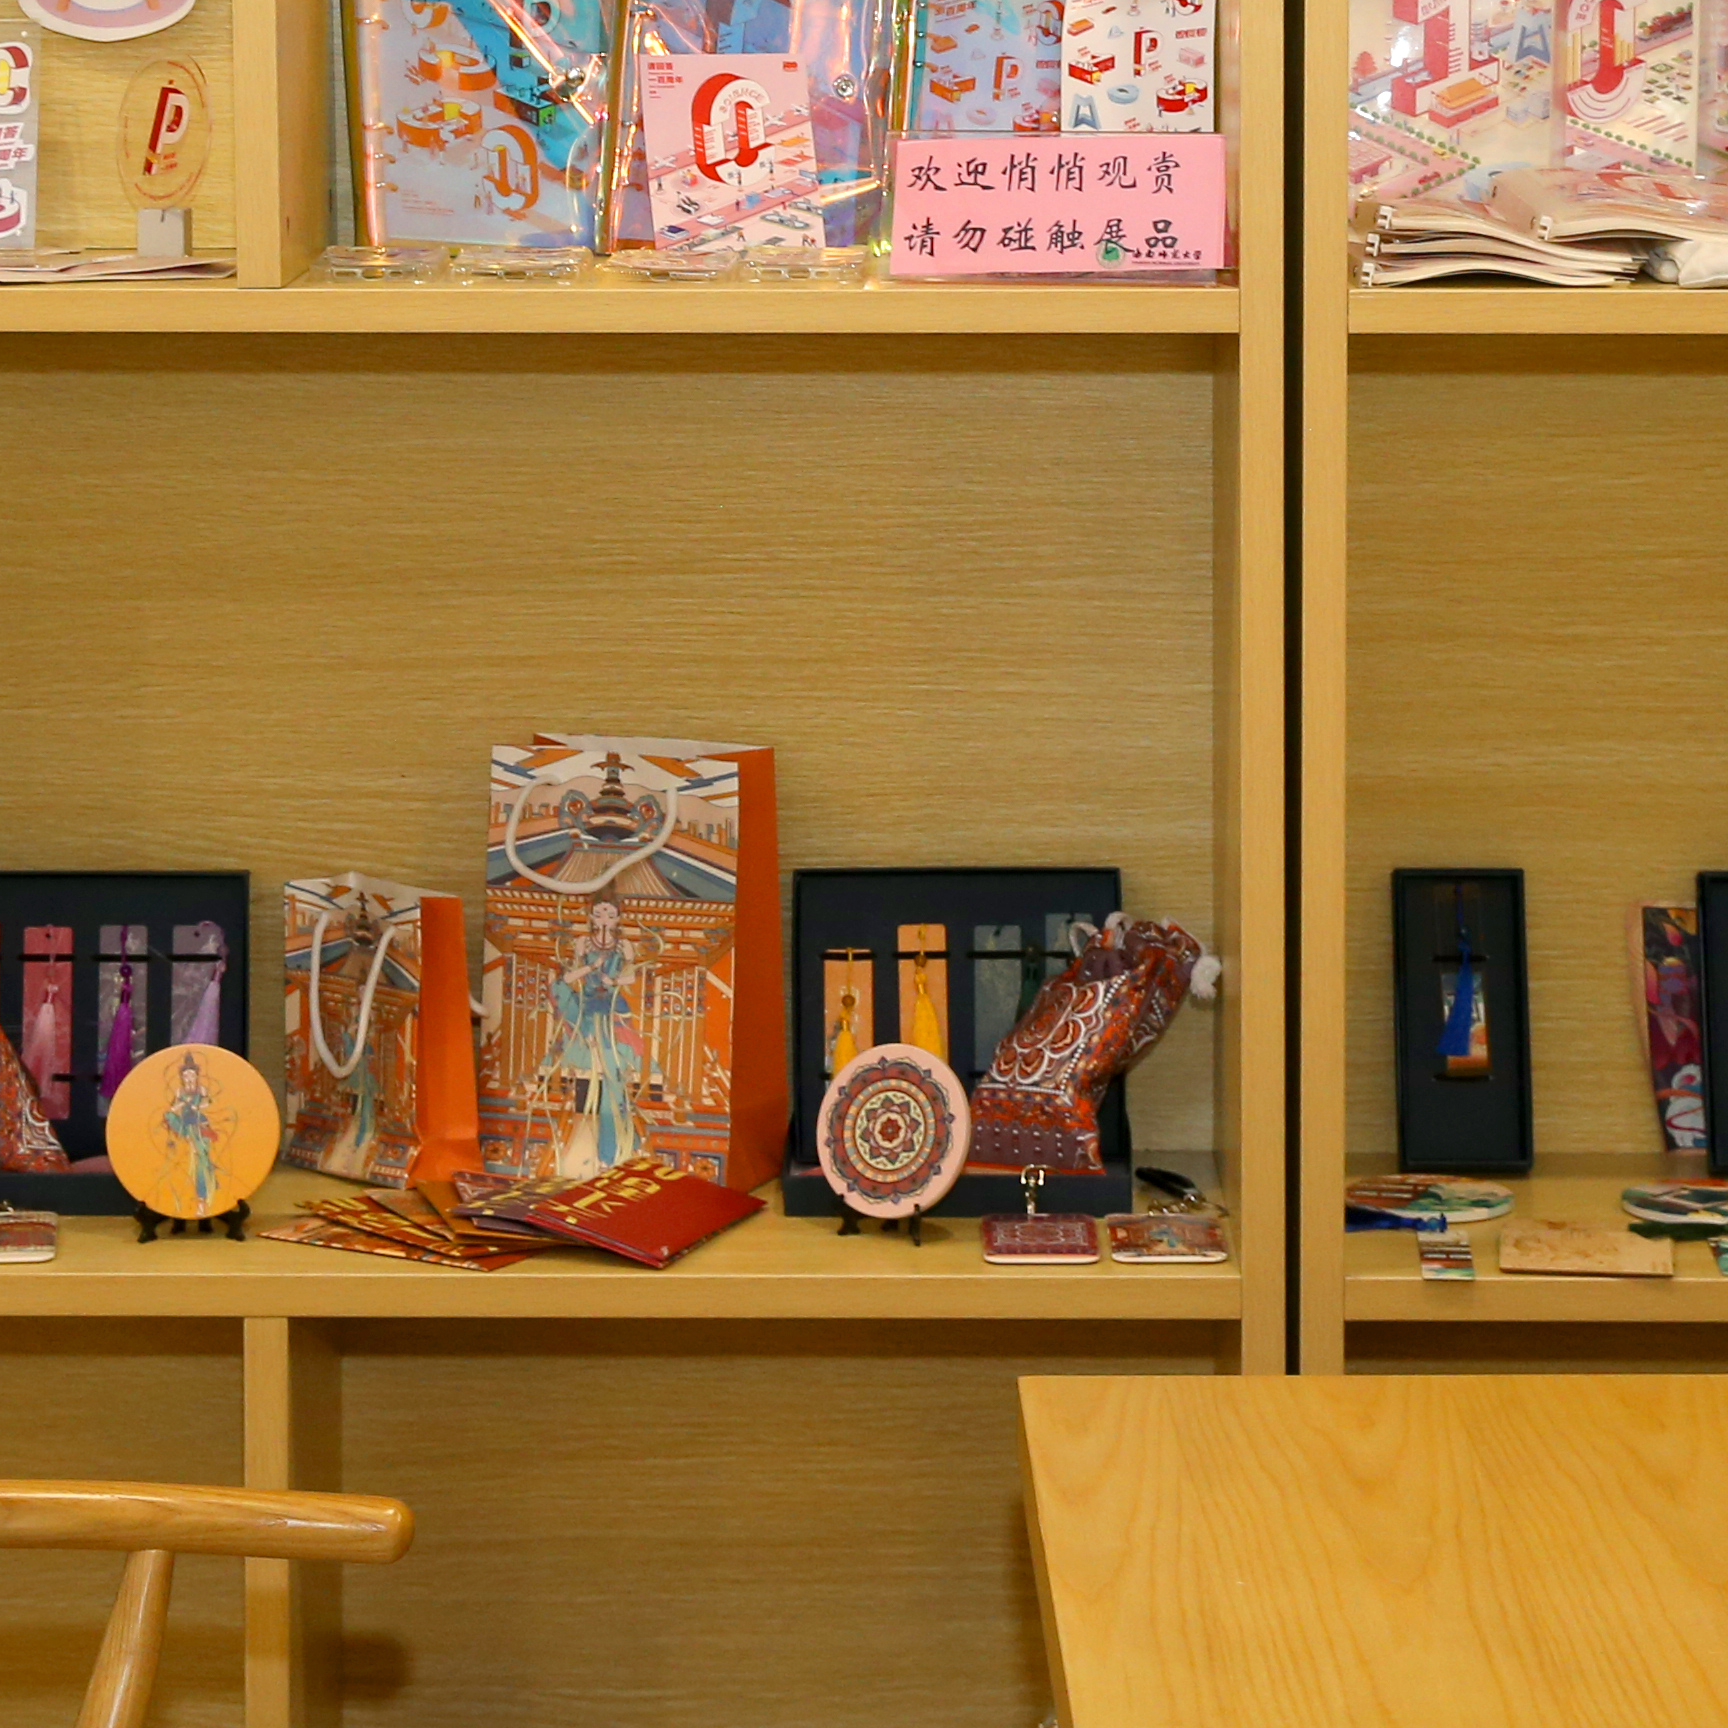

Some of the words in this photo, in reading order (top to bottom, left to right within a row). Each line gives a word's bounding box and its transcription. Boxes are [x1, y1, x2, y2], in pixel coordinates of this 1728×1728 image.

[906, 151, 1181, 194] 欢迎悄悄观赏
[903, 216, 1178, 257] 请勿碰触展品
